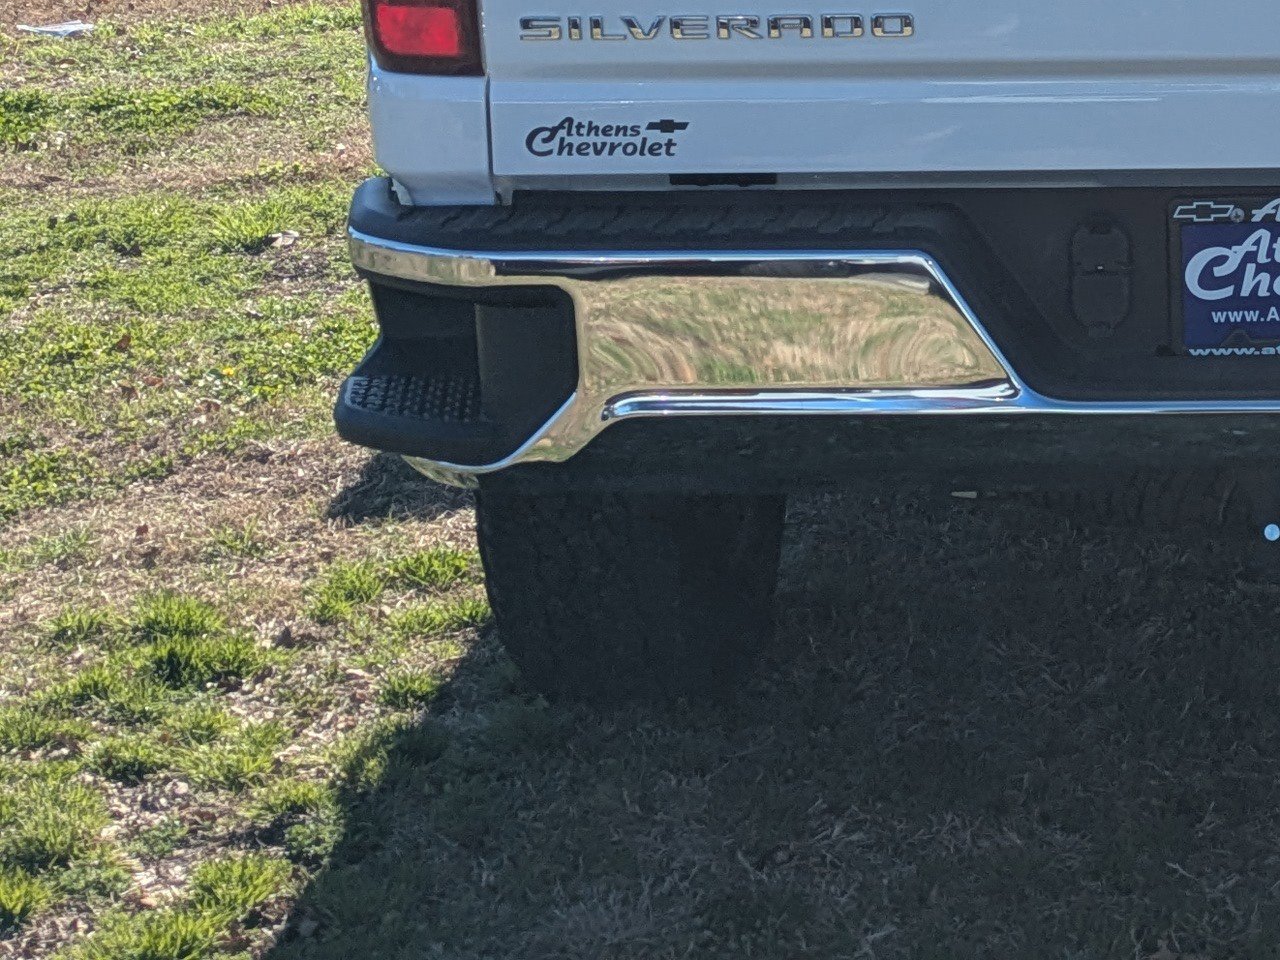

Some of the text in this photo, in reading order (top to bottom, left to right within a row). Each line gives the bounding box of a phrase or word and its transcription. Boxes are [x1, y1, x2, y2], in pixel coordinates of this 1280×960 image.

[519, 13, 916, 40] SILVERADO
[551, 116, 642, 138] Athens
[525, 126, 678, 158] Chevrolet
